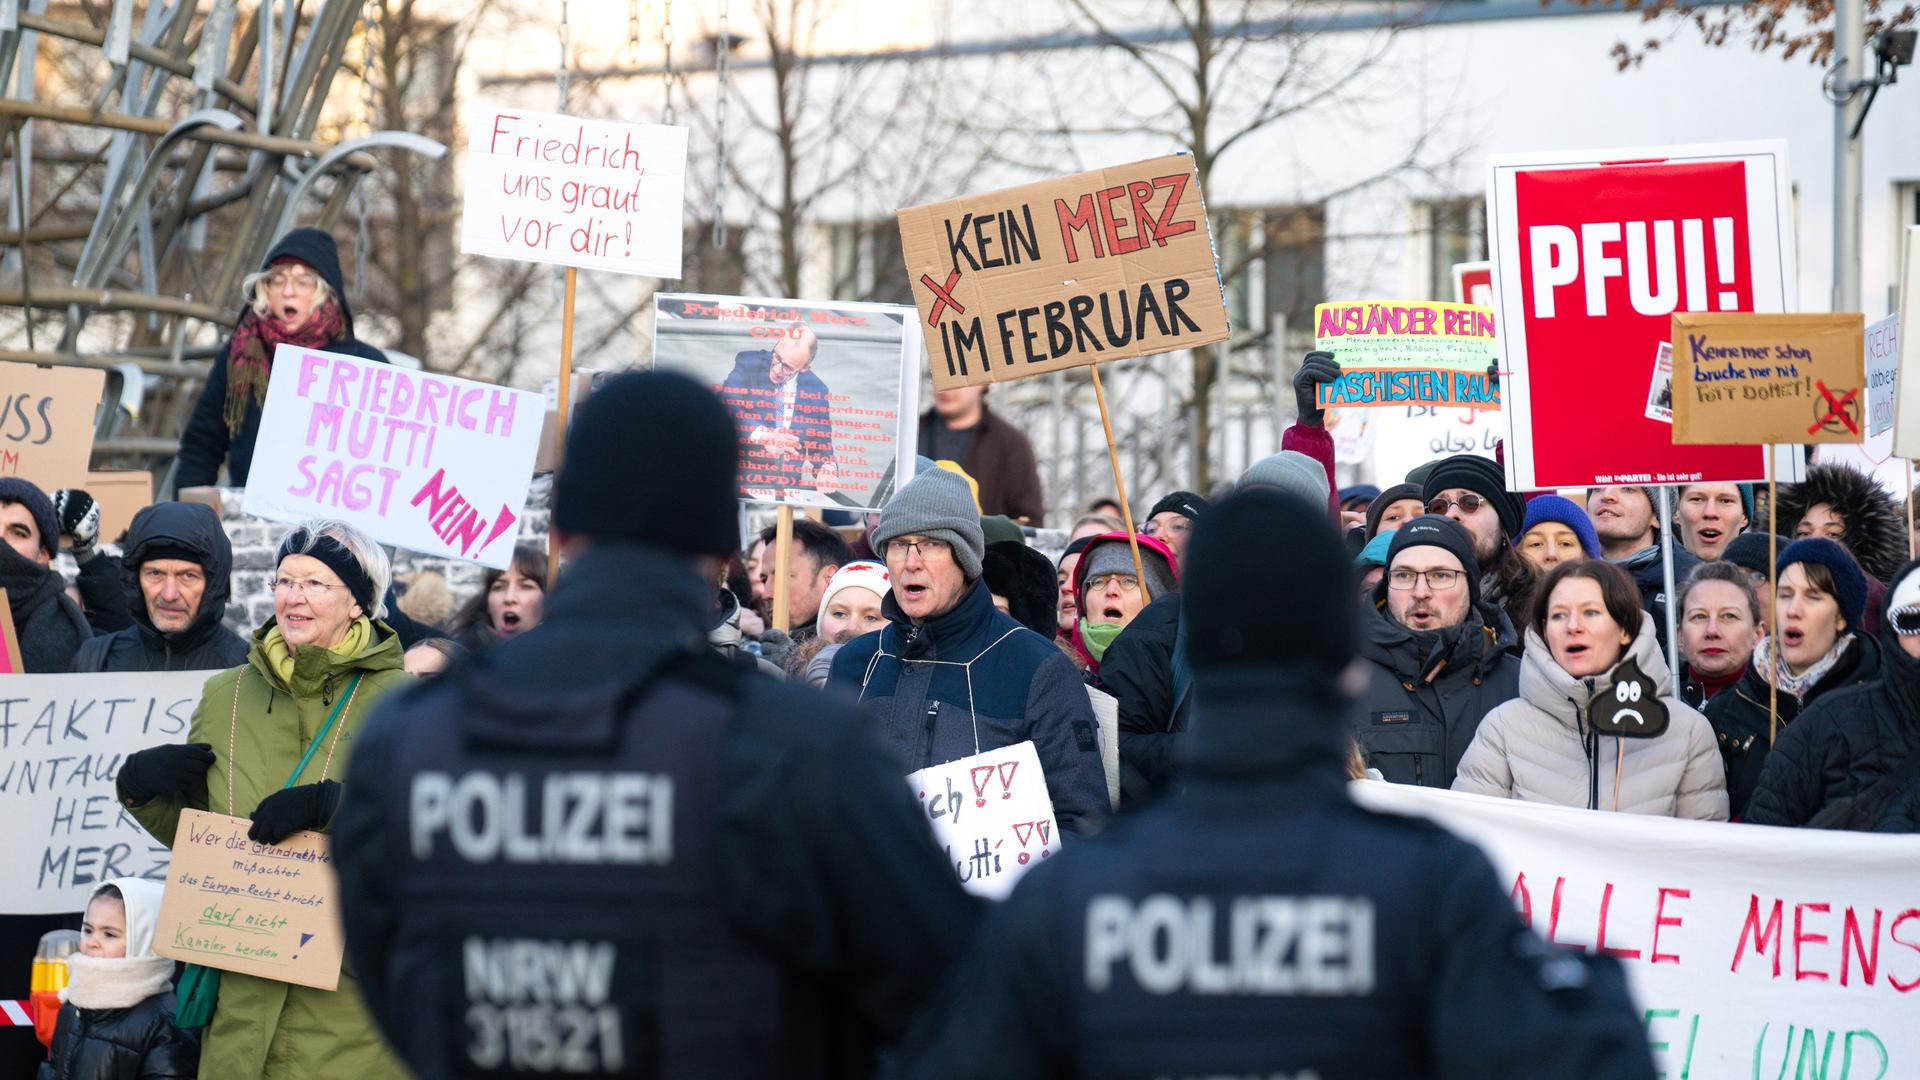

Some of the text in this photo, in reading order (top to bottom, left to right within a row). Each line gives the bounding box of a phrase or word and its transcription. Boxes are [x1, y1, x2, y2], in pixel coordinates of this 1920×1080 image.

[490, 114, 645, 175] Friedrich,
[503, 173, 641, 214] uns graut
[501, 214, 632, 258] vor dir!
[944, 172, 1196, 274] KEIN MERZ
[1529, 216, 1739, 319] PFUI!
[750, 325, 805, 340] CDU
[810, 309, 867, 327] Merz
[939, 278, 1202, 376] IM FEBRUAR
[1317, 303, 1496, 339] AUSLÄNDER REIN
[1868, 321, 1899, 360] RECH
[1319, 370, 1449, 405] FASCHISTEN
[1747, 366, 1772, 379] mer
[296, 354, 518, 438] FRIEDRICH
[799, 389, 821, 400] bei
[304, 402, 438, 469] MUTTI
[805, 428, 851, 439] Sache
[854, 433, 892, 442] auch
[1430, 429, 1476, 453] also
[287, 454, 402, 517] SAGT
[799, 479, 868, 491] zustande
[854, 470, 881, 479] mit
[409, 467, 517, 560] NEIN!
[189, 822, 222, 846] Wer
[225, 830, 247, 850] die
[409, 770, 674, 865] POLIZEI
[37, 842, 171, 890] MERZ
[178, 872, 198, 886] das
[282, 890, 324, 906] bricht
[202, 902, 288, 929] darf nicht
[1510, 871, 1691, 964] ALLE
[174, 921, 227, 951] Kanzler
[235, 943, 278, 959] werden
[1085, 895, 1375, 995] POLIZEI
[463, 936, 615, 1007] NRW
[1751, 1021, 1889, 1080] UND
